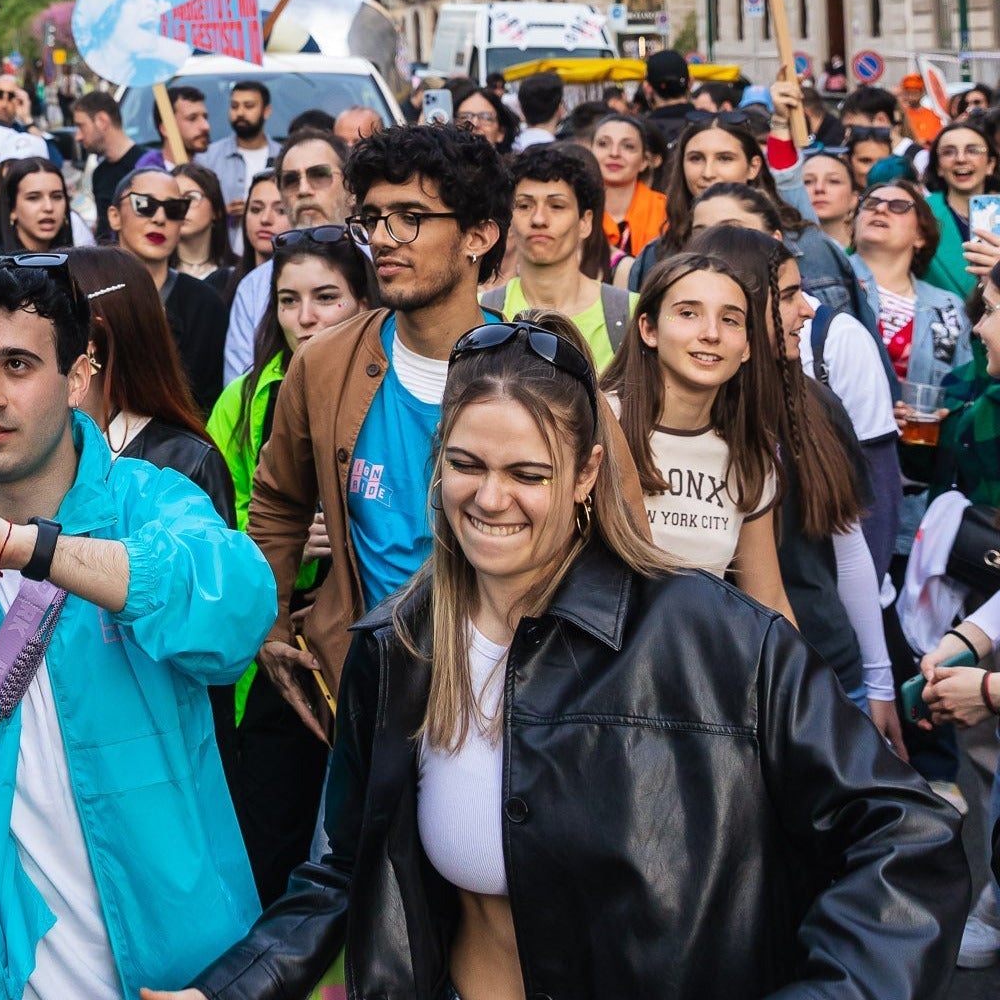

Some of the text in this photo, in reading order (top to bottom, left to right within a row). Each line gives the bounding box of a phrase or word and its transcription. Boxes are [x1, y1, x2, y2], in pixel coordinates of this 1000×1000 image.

[353, 460, 383, 480] IGN
[351, 478, 386, 499] RIDE
[660, 468, 727, 508] ONX
[661, 511, 698, 528] YORK
[701, 515, 729, 530] CITY
